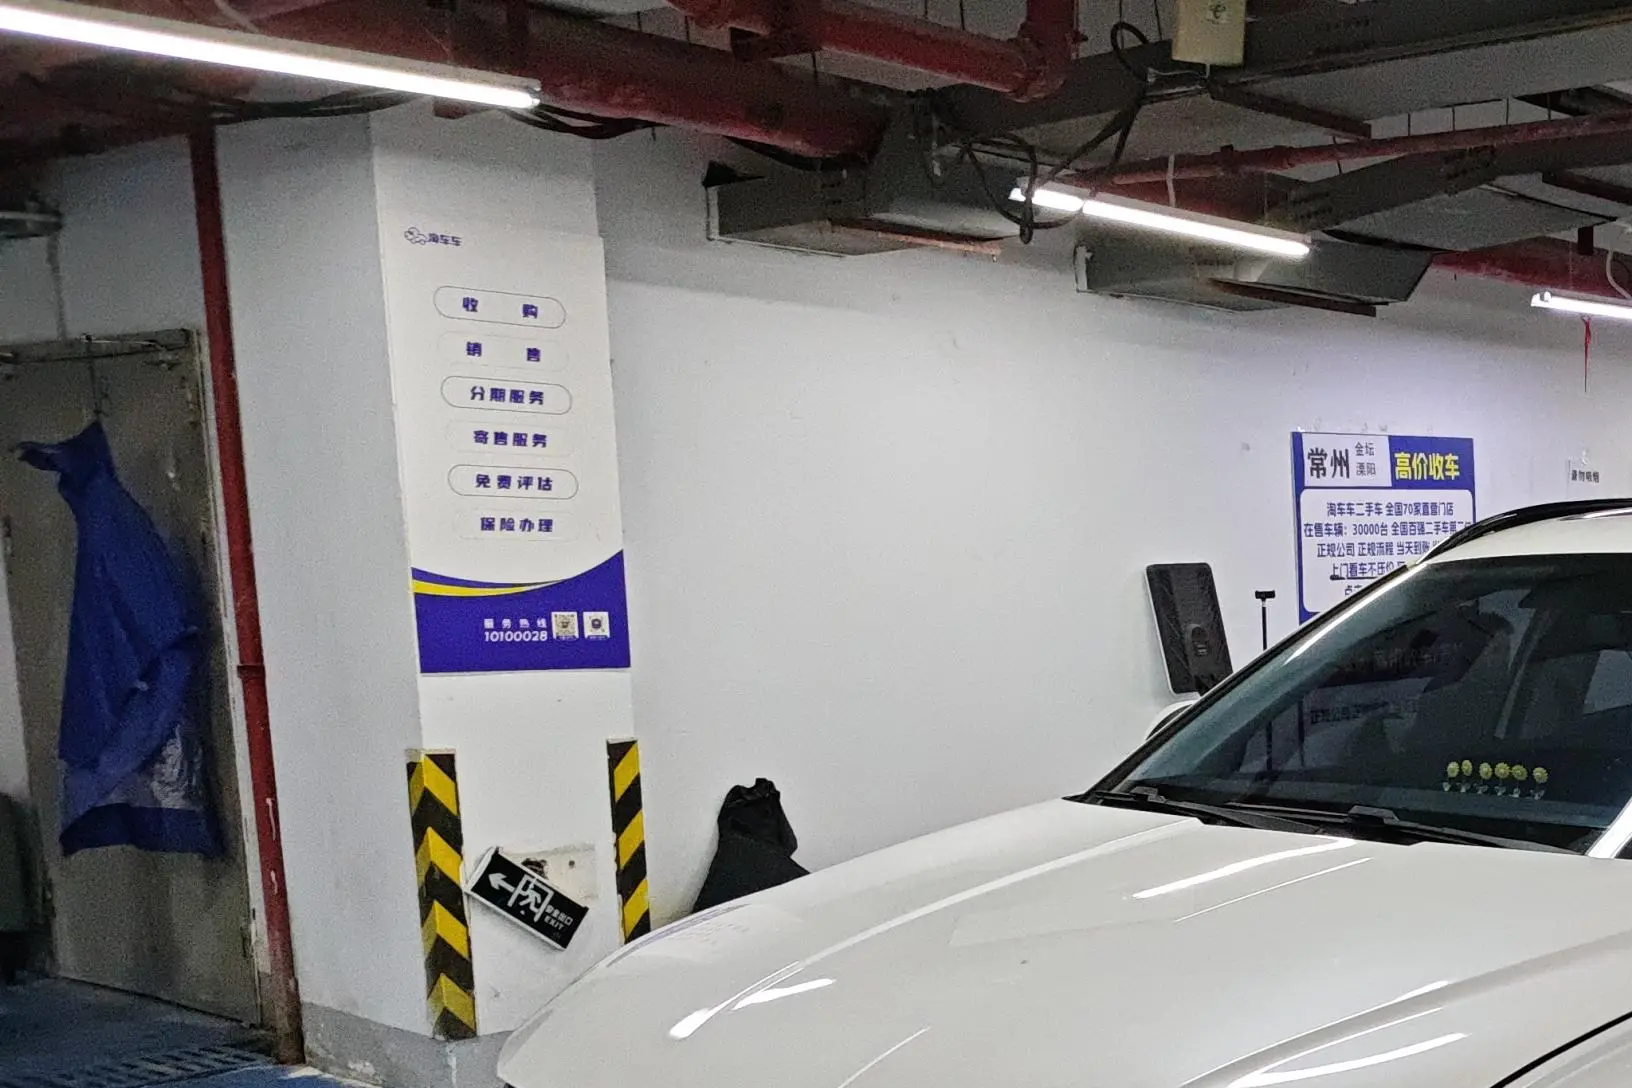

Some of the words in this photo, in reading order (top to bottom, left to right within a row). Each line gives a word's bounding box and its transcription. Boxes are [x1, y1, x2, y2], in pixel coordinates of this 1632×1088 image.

[470, 386, 544, 405] 分期服务
[473, 430, 547, 448] 寄售服务
[1355, 441, 1375, 457] 金坛
[1307, 447, 1349, 479] 常州
[1356, 462, 1376, 477] 溧阳
[1394, 451, 1461, 481] 高价收车
[475, 473, 553, 491] 免费评估
[1327, 502, 1383, 517] 淘车车二手车
[1385, 501, 1454, 516] 全国70家直营门店
[480, 517, 553, 533] 保险办理
[1316, 543, 1355, 558] 正规公司
[1357, 542, 1394, 557] 正规流程
[484, 630, 548, 642] 10100028
[543, 914, 564, 930] EXIT
